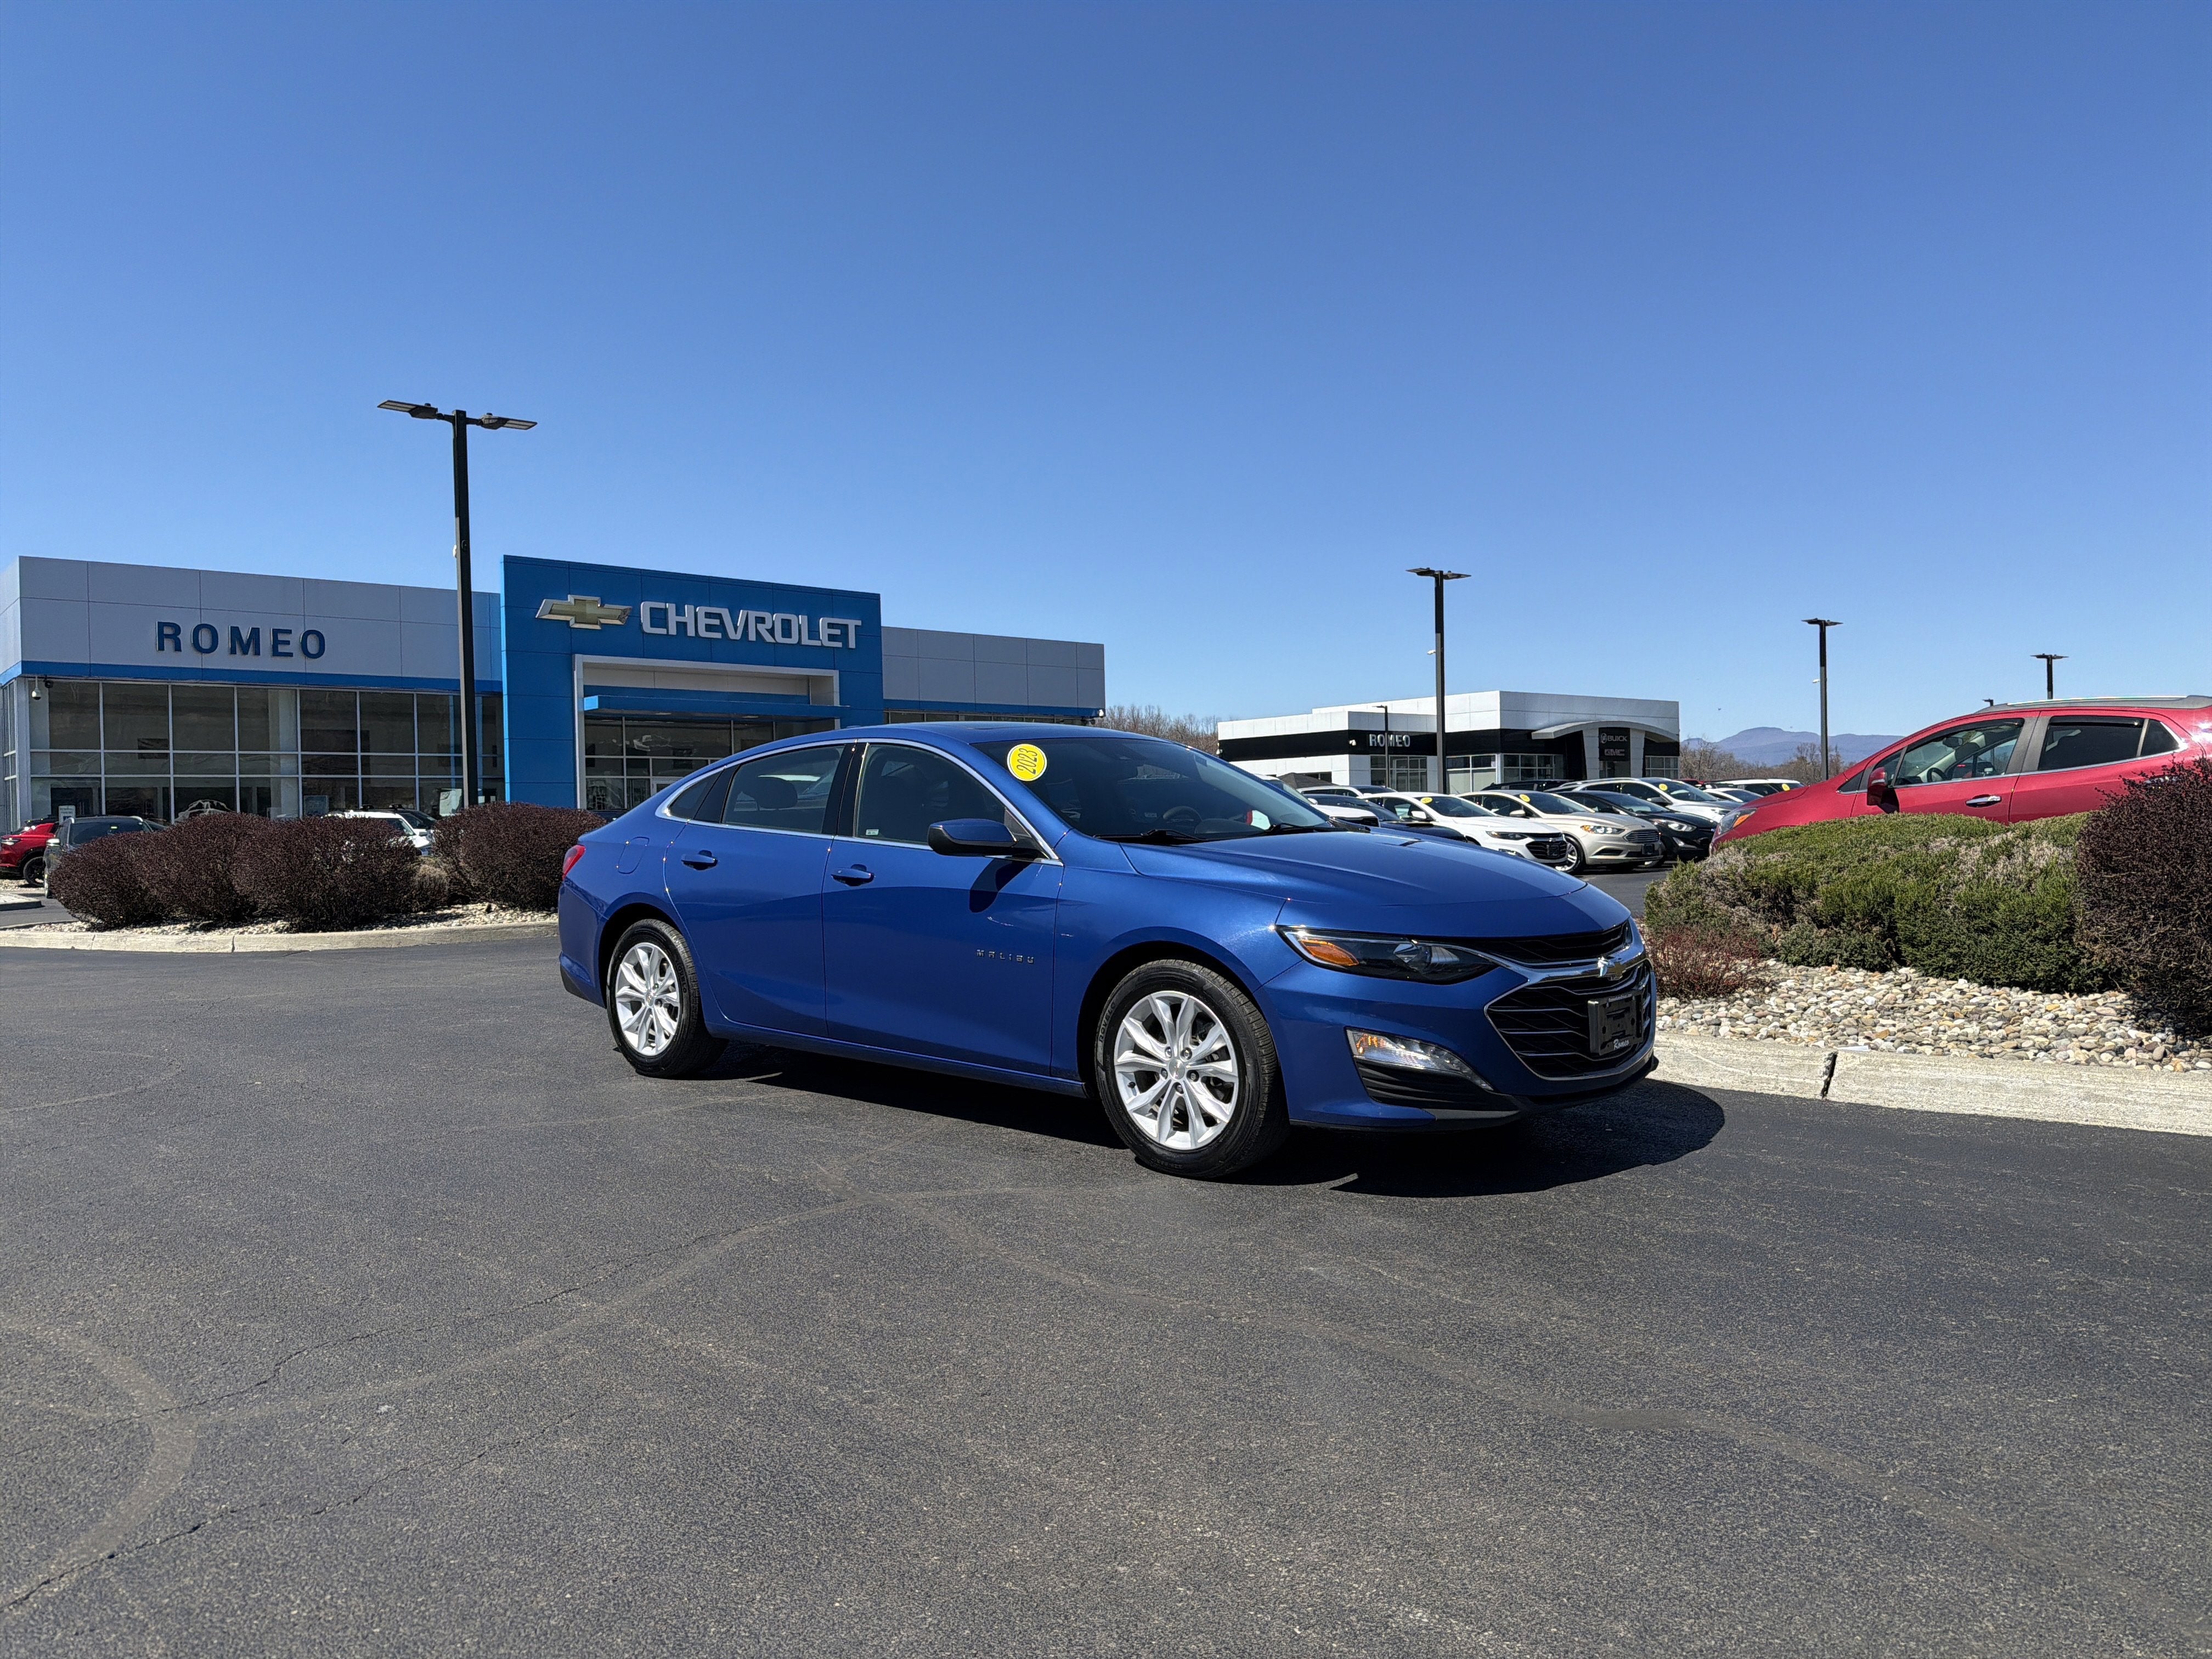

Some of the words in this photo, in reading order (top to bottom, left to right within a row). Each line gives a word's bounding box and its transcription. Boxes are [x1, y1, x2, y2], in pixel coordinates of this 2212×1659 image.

[640, 601, 862, 649] CHEVROLET
[156, 621, 325, 659] ROMEO
[1369, 733, 1410, 747] ROMEO
[1016, 748, 1038, 775] 2023
[977, 949, 1034, 963] MALIBU
[1099, 1001, 1118, 1043] ROVELO
[1613, 1039, 1629, 1050] Romeo
